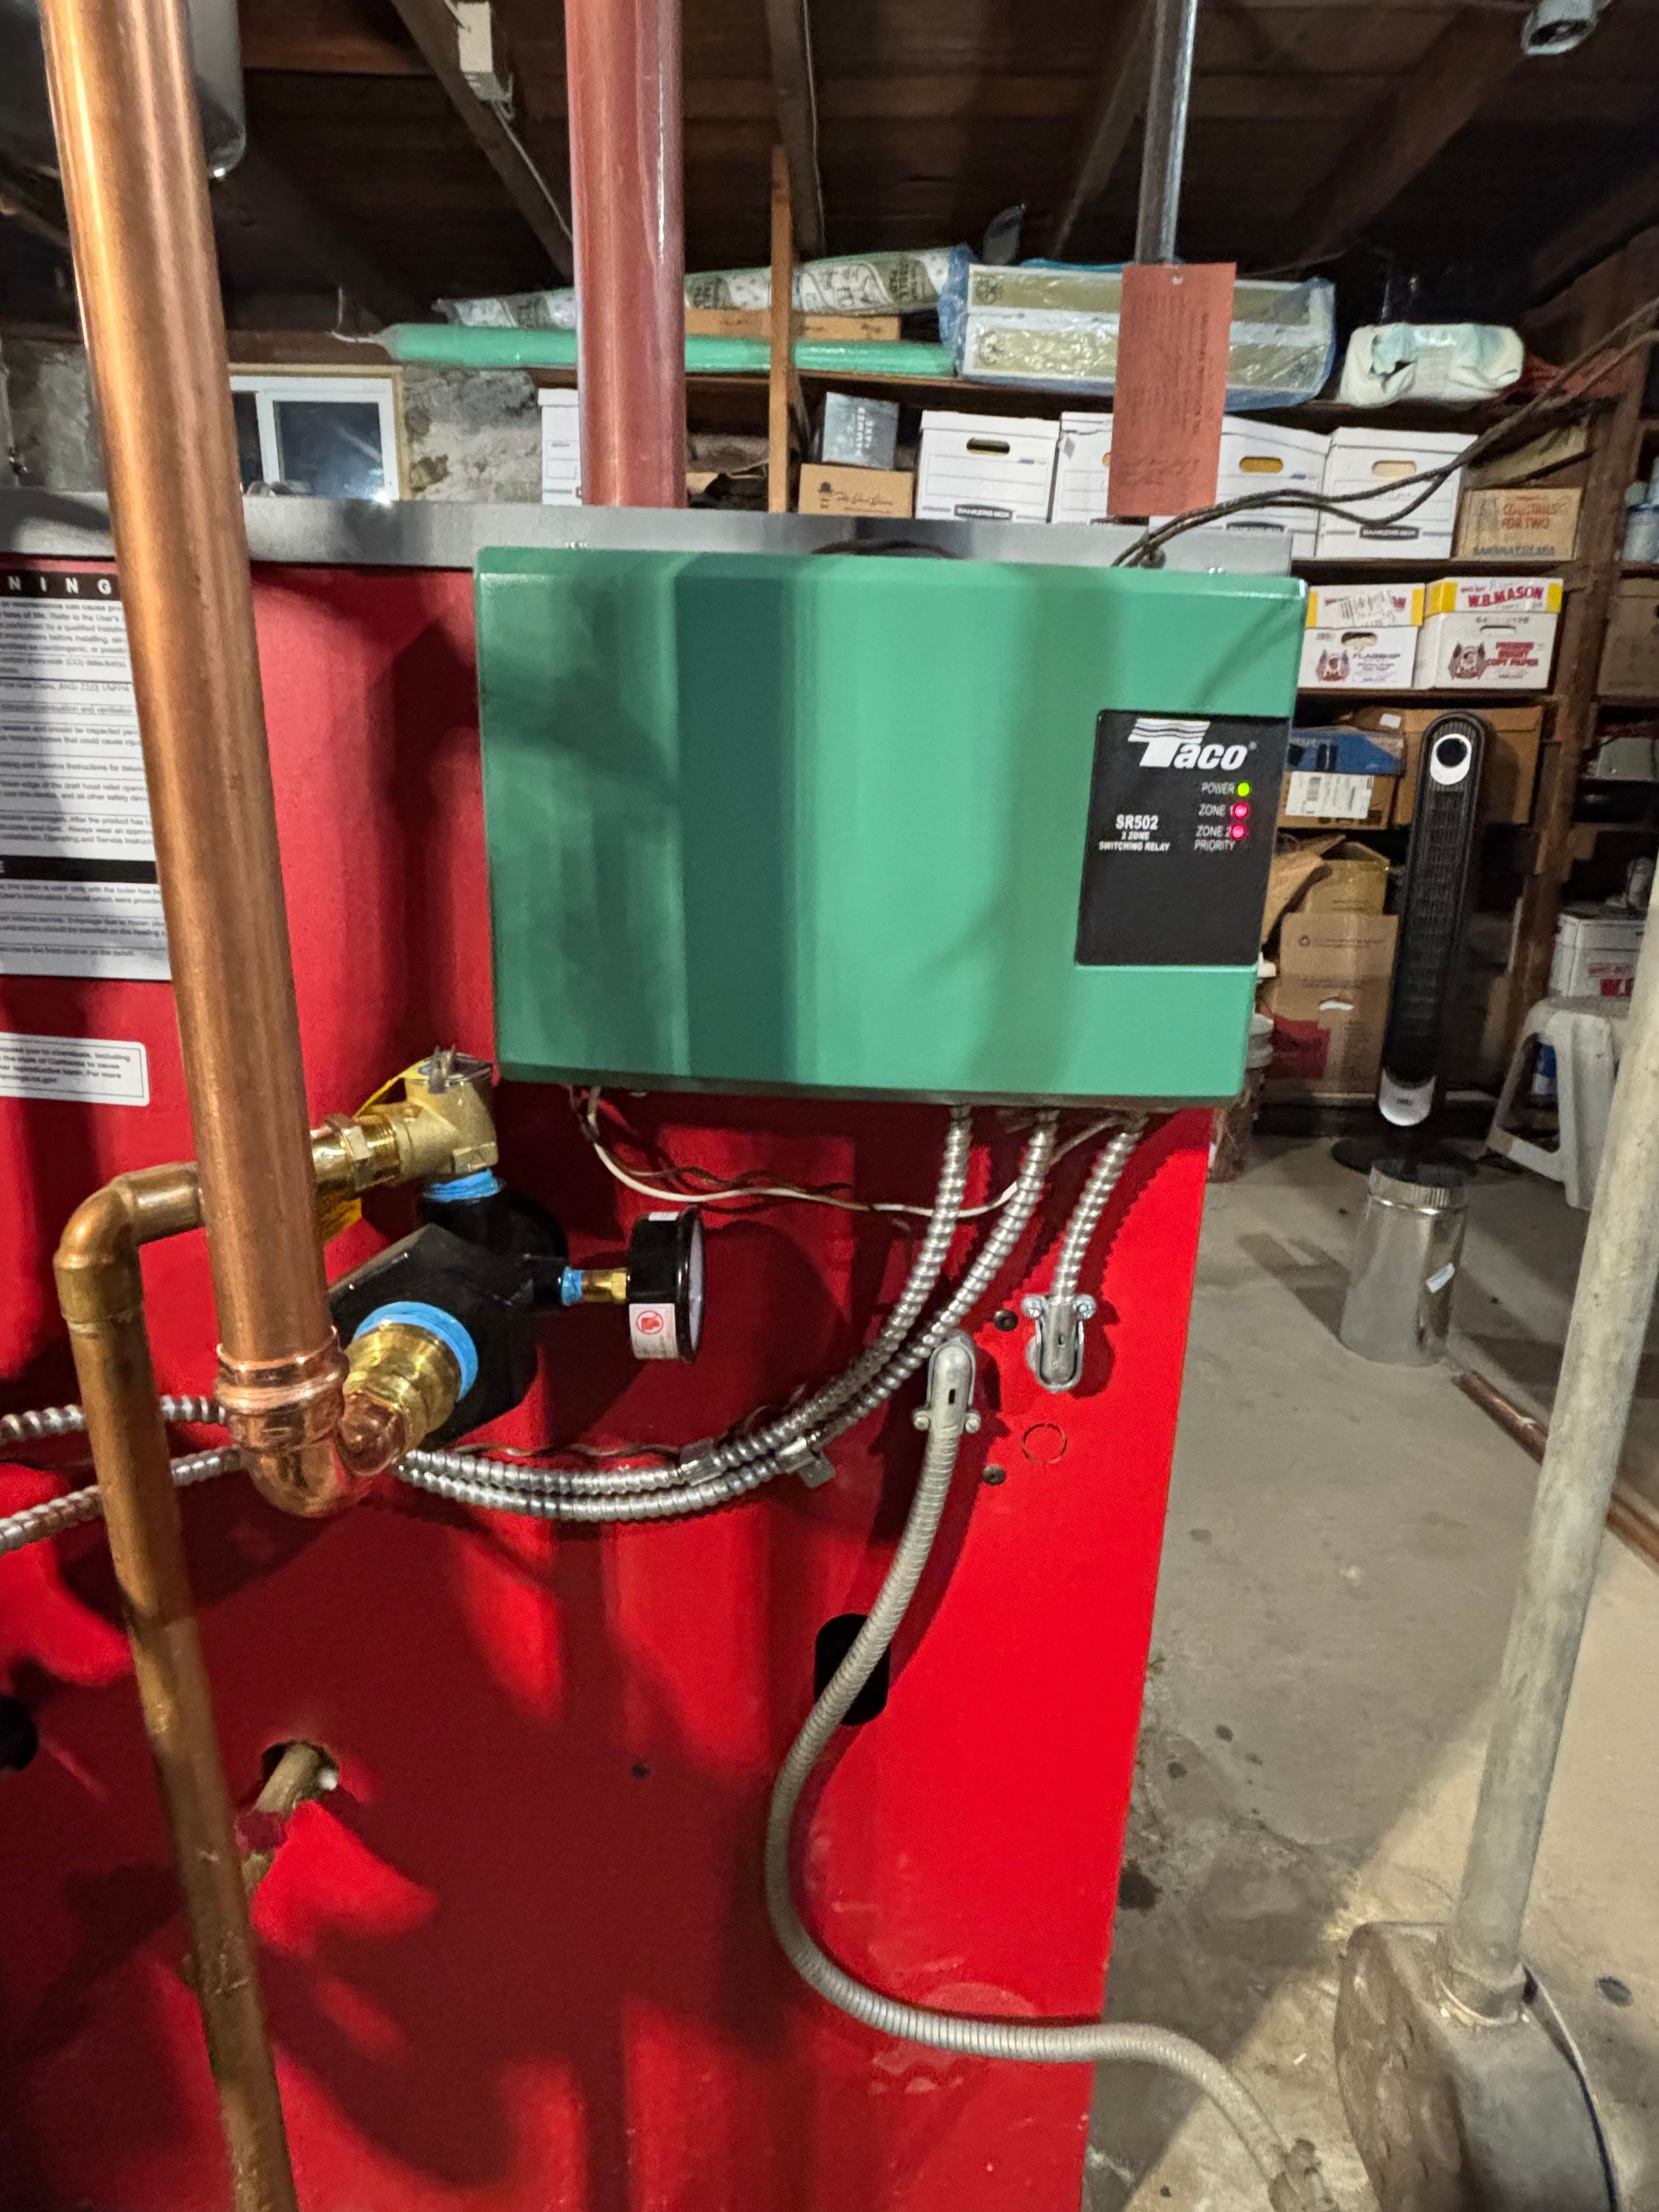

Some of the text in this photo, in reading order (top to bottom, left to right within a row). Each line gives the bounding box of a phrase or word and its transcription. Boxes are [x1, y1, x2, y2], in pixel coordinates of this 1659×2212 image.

[1201, 781, 1235, 795] POWER
[1198, 804, 1226, 817] ZONE
[1115, 814, 1159, 831] SR502
[1127, 831, 1150, 841] ZONE
[1195, 823, 1232, 837] ZONE 2
[1098, 840, 1171, 852] SWITCHING RELAY
[1194, 839, 1237, 851] PRIORITY
